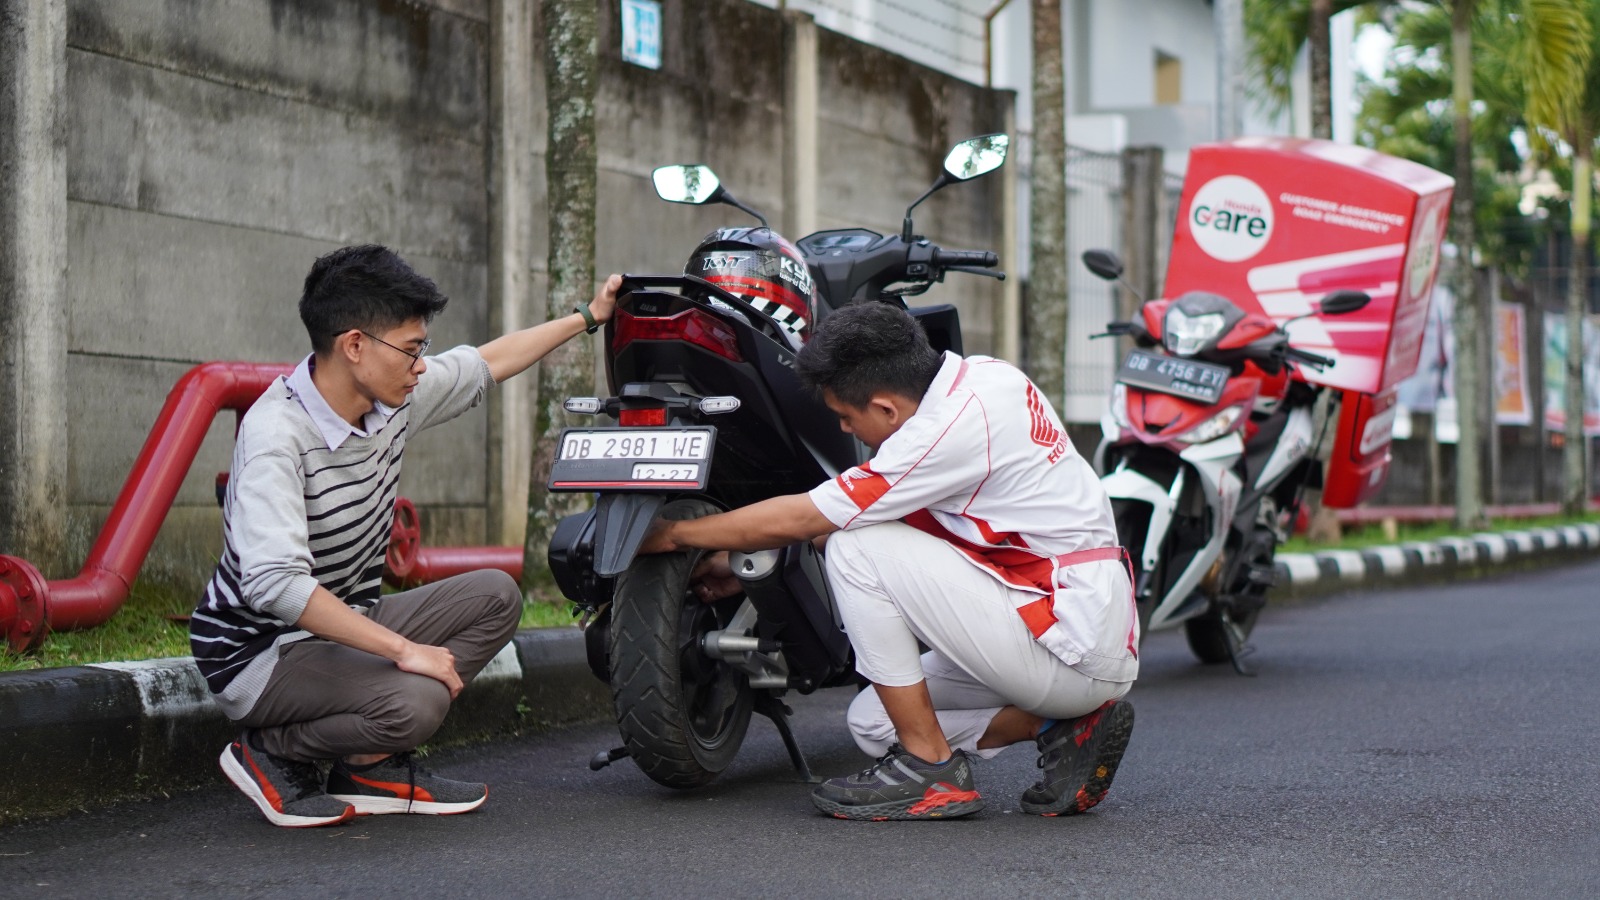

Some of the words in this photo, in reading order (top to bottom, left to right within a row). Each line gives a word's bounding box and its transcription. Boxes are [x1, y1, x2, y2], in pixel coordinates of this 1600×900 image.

[1280, 192, 1338, 213] CUSTOMER
[1340, 204, 1405, 227] ASSISTANCE
[1292, 206, 1322, 221] ROAD
[1324, 211, 1389, 234] EMERGENCY
[703, 256, 750, 270] KYT
[1128, 354, 1149, 371] DB
[1157, 360, 1195, 380] 4756
[1200, 369, 1220, 386] FY
[566, 438, 590, 459] DB
[603, 437, 657, 457] 2981
[673, 436, 702, 457] WE
